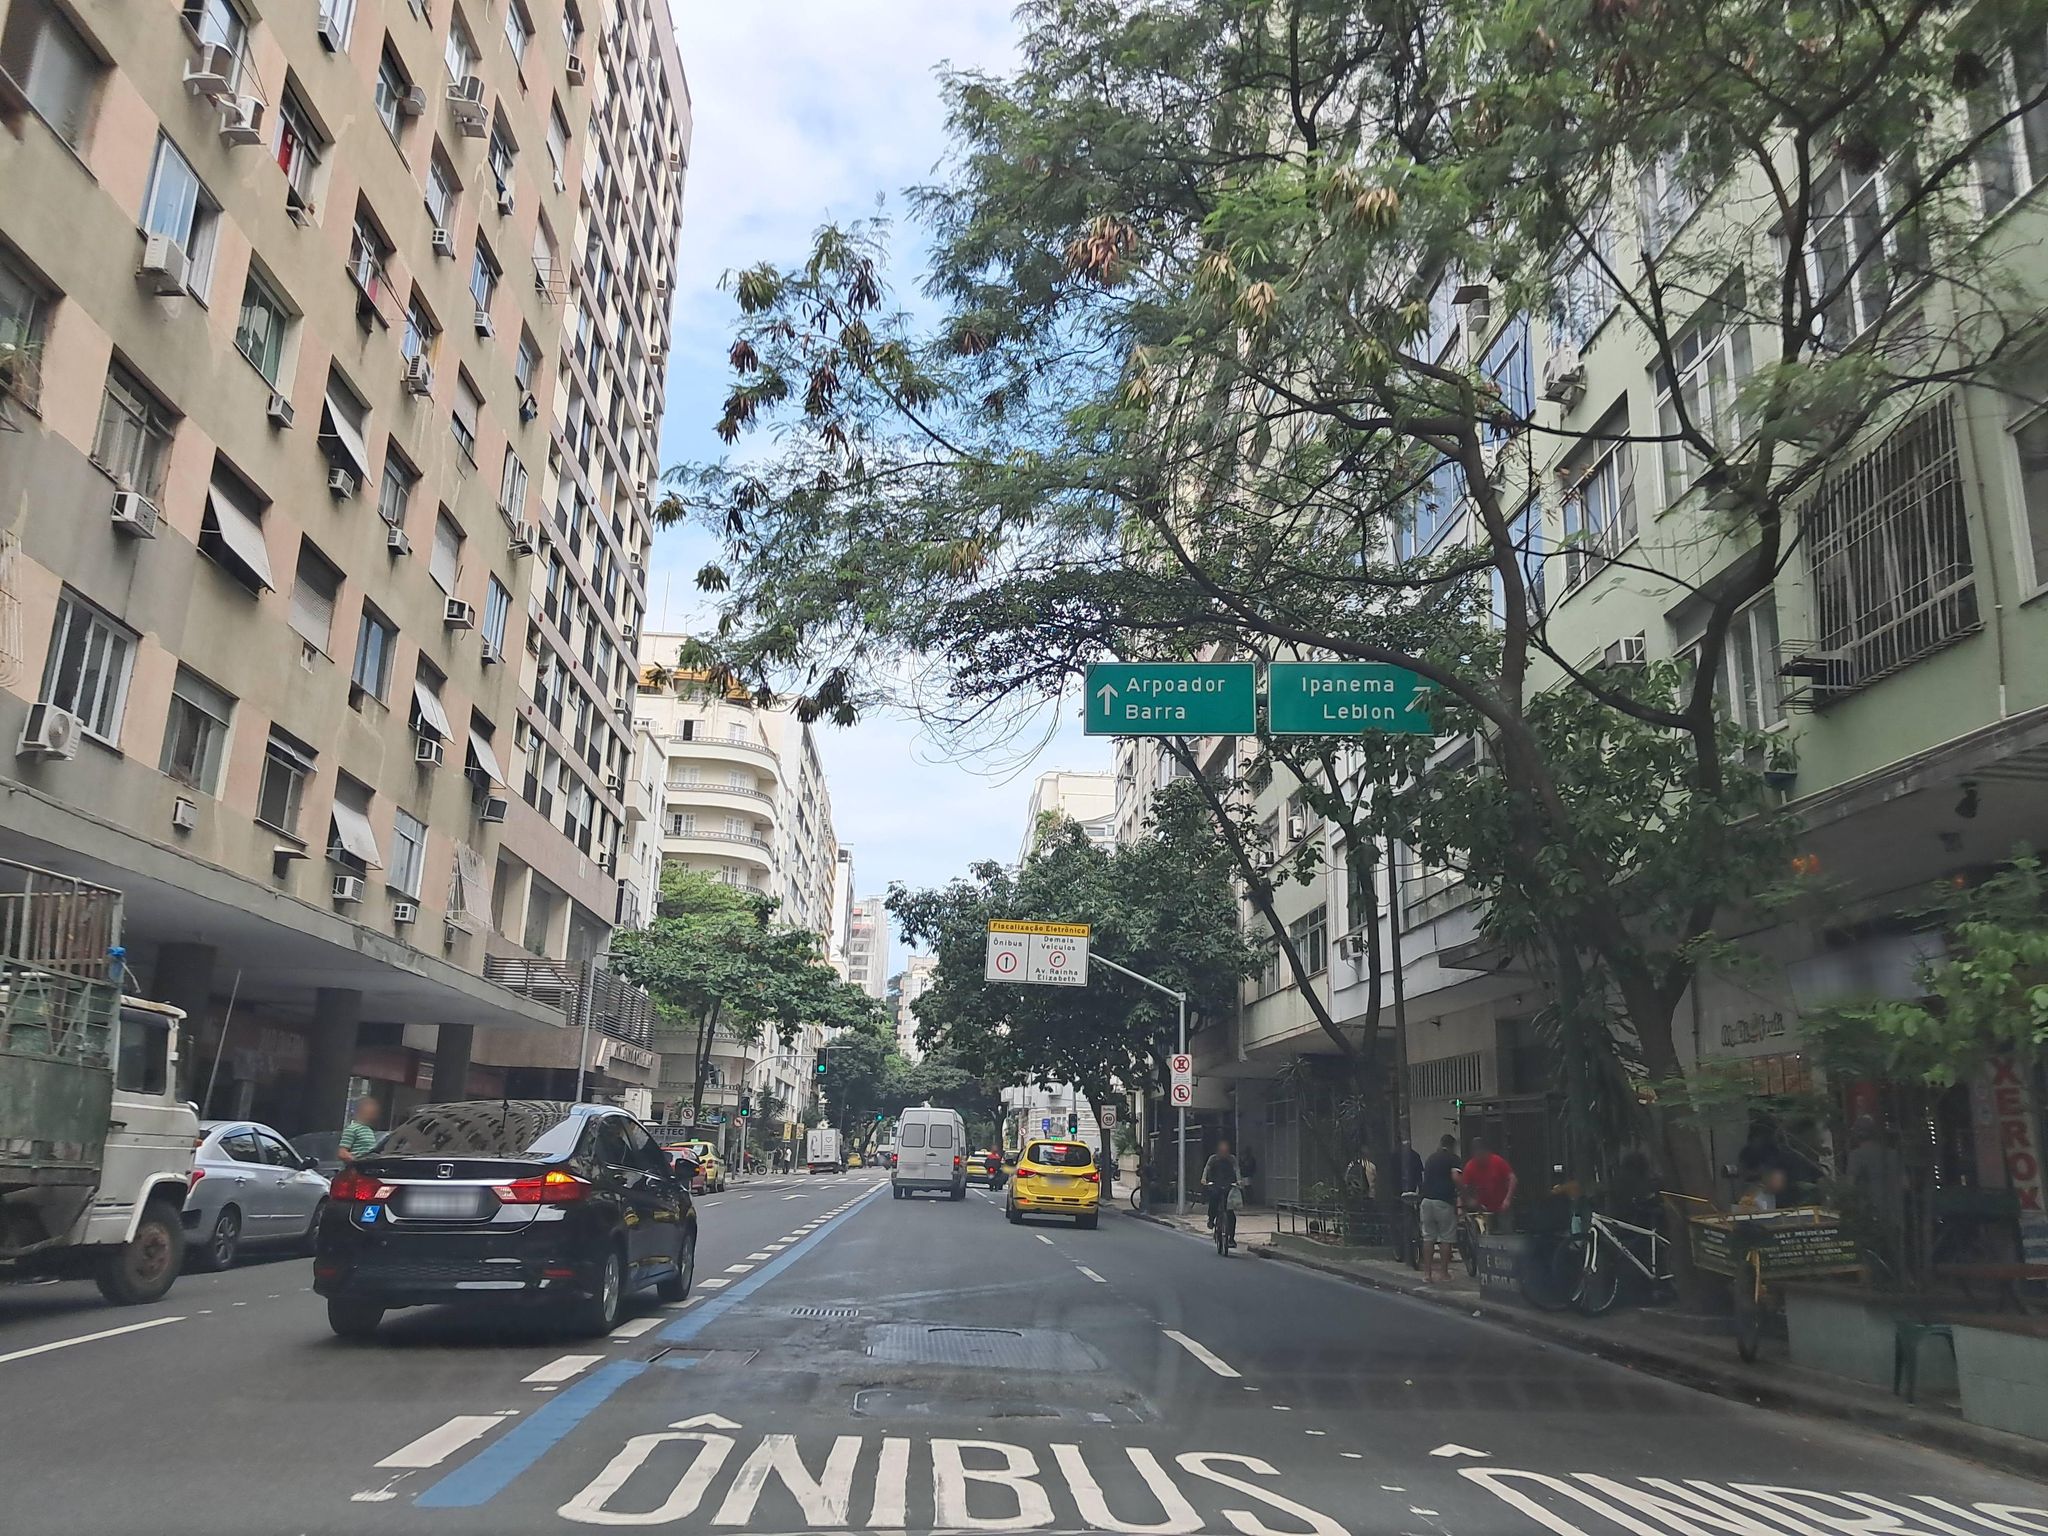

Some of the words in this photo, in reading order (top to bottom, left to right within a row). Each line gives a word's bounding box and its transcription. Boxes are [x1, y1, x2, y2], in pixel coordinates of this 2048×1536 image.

[1126, 677, 1225, 697] Arpoador
[1302, 677, 1395, 697] Ipanema
[1125, 704, 1186, 719] Barra
[1323, 704, 1395, 719] Leblon
[992, 922, 1043, 933] Fiscalização
[1045, 925, 1086, 934] Eletrônica
[993, 937, 1023, 947] Ônibus
[1043, 936, 1074, 944] Demais
[1037, 974, 1076, 982] Elizabeth
[1049, 968, 1078, 976] Rainha
[1988, 1056, 2041, 1211] XEROX
[556, 1413, 1352, 1536] ÔNIBUS
